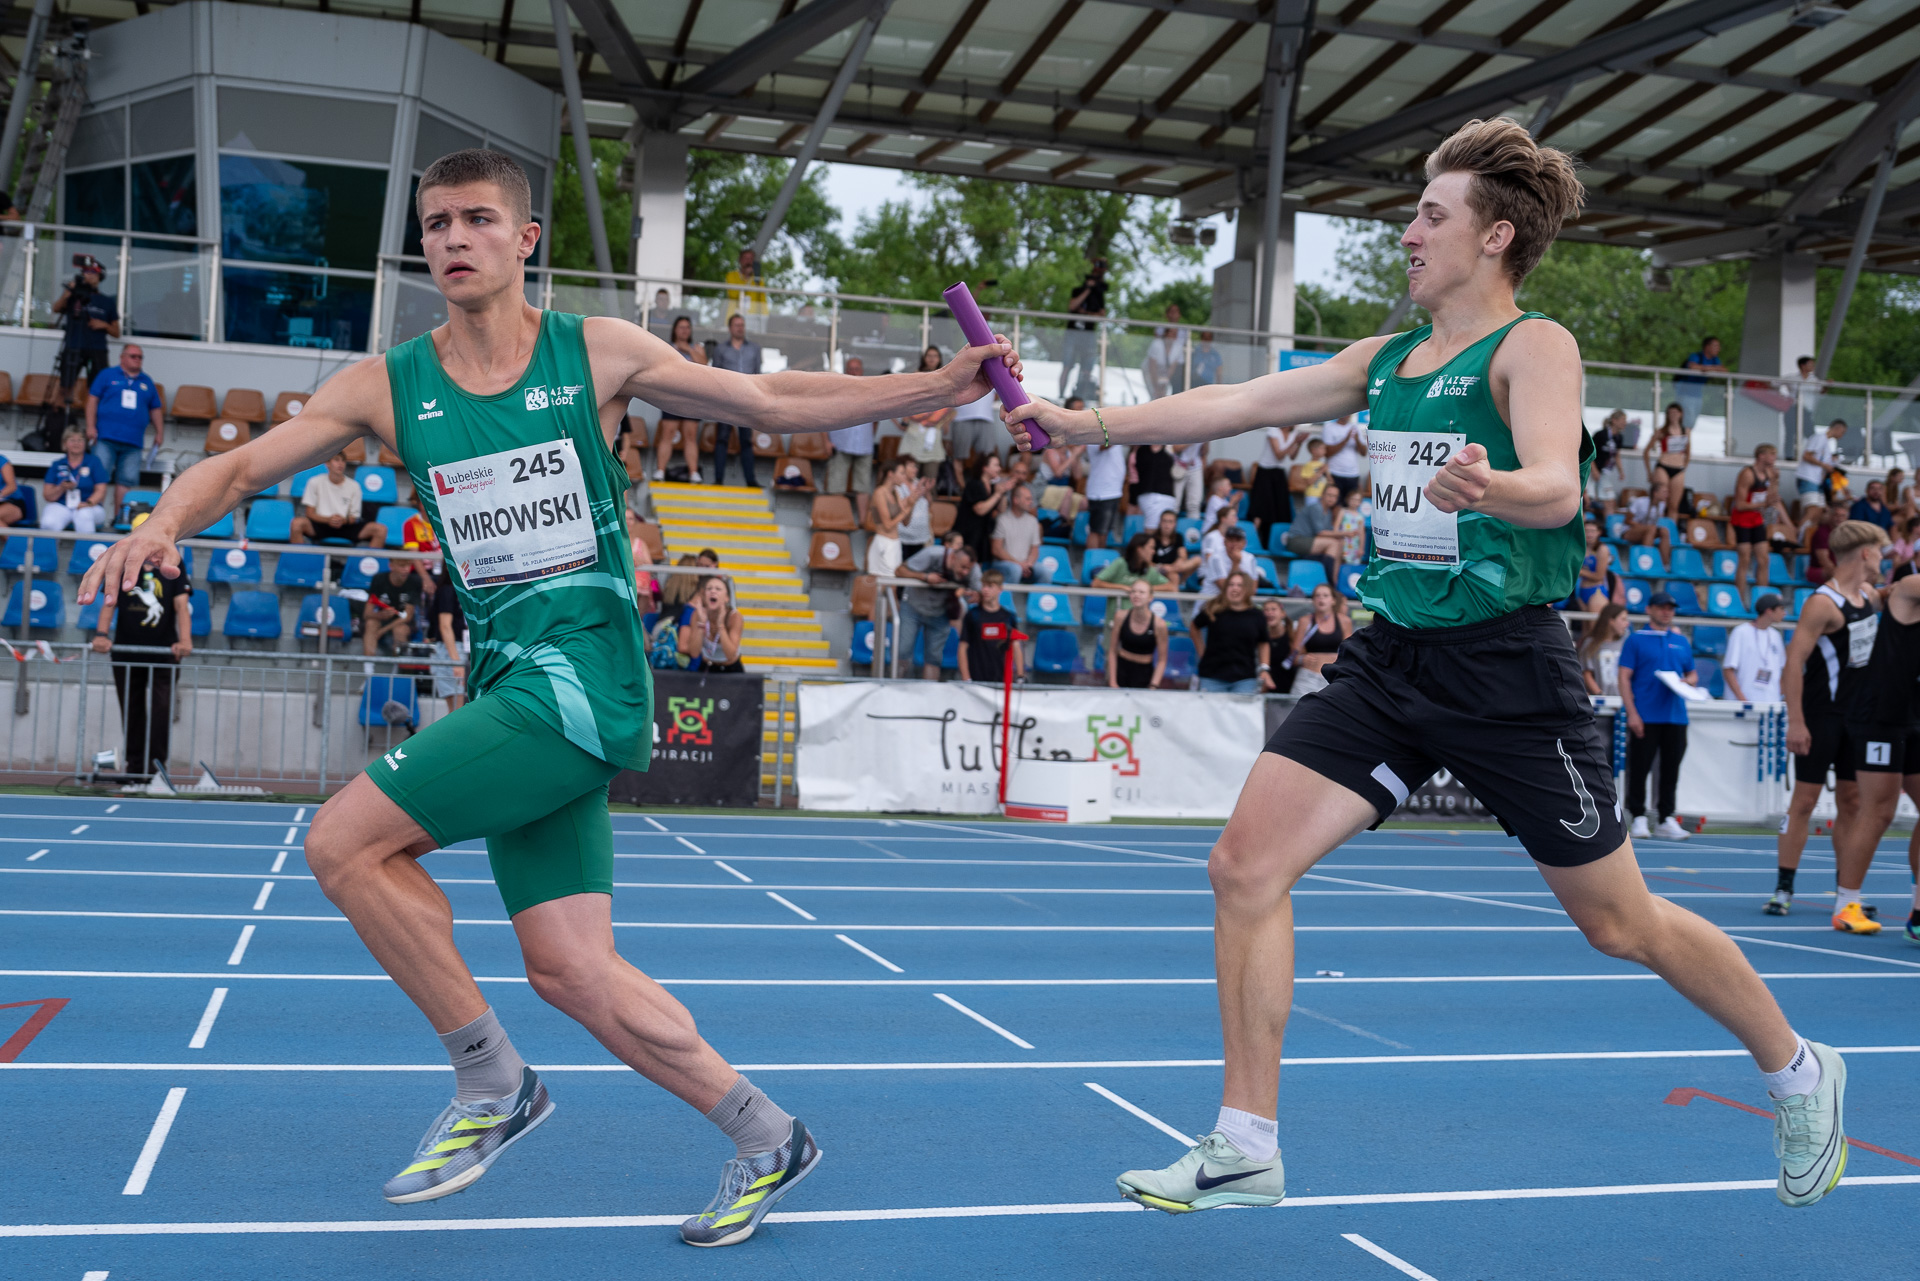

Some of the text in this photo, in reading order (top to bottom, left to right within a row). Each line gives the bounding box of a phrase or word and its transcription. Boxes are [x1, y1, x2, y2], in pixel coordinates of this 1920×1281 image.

[418, 410, 443, 420] erima
[1408, 440, 1451, 467] 242
[447, 466, 494, 485] lubelskie
[509, 449, 565, 484] 245
[1375, 482, 1422, 514] MAJ
[450, 492, 582, 545] MIROWSKI
[474, 553, 515, 566] LUBELSKIE
[477, 565, 496, 575] 2024
[651, 748, 713, 764] PIRACJI
[1873, 744, 1883, 762] 1
